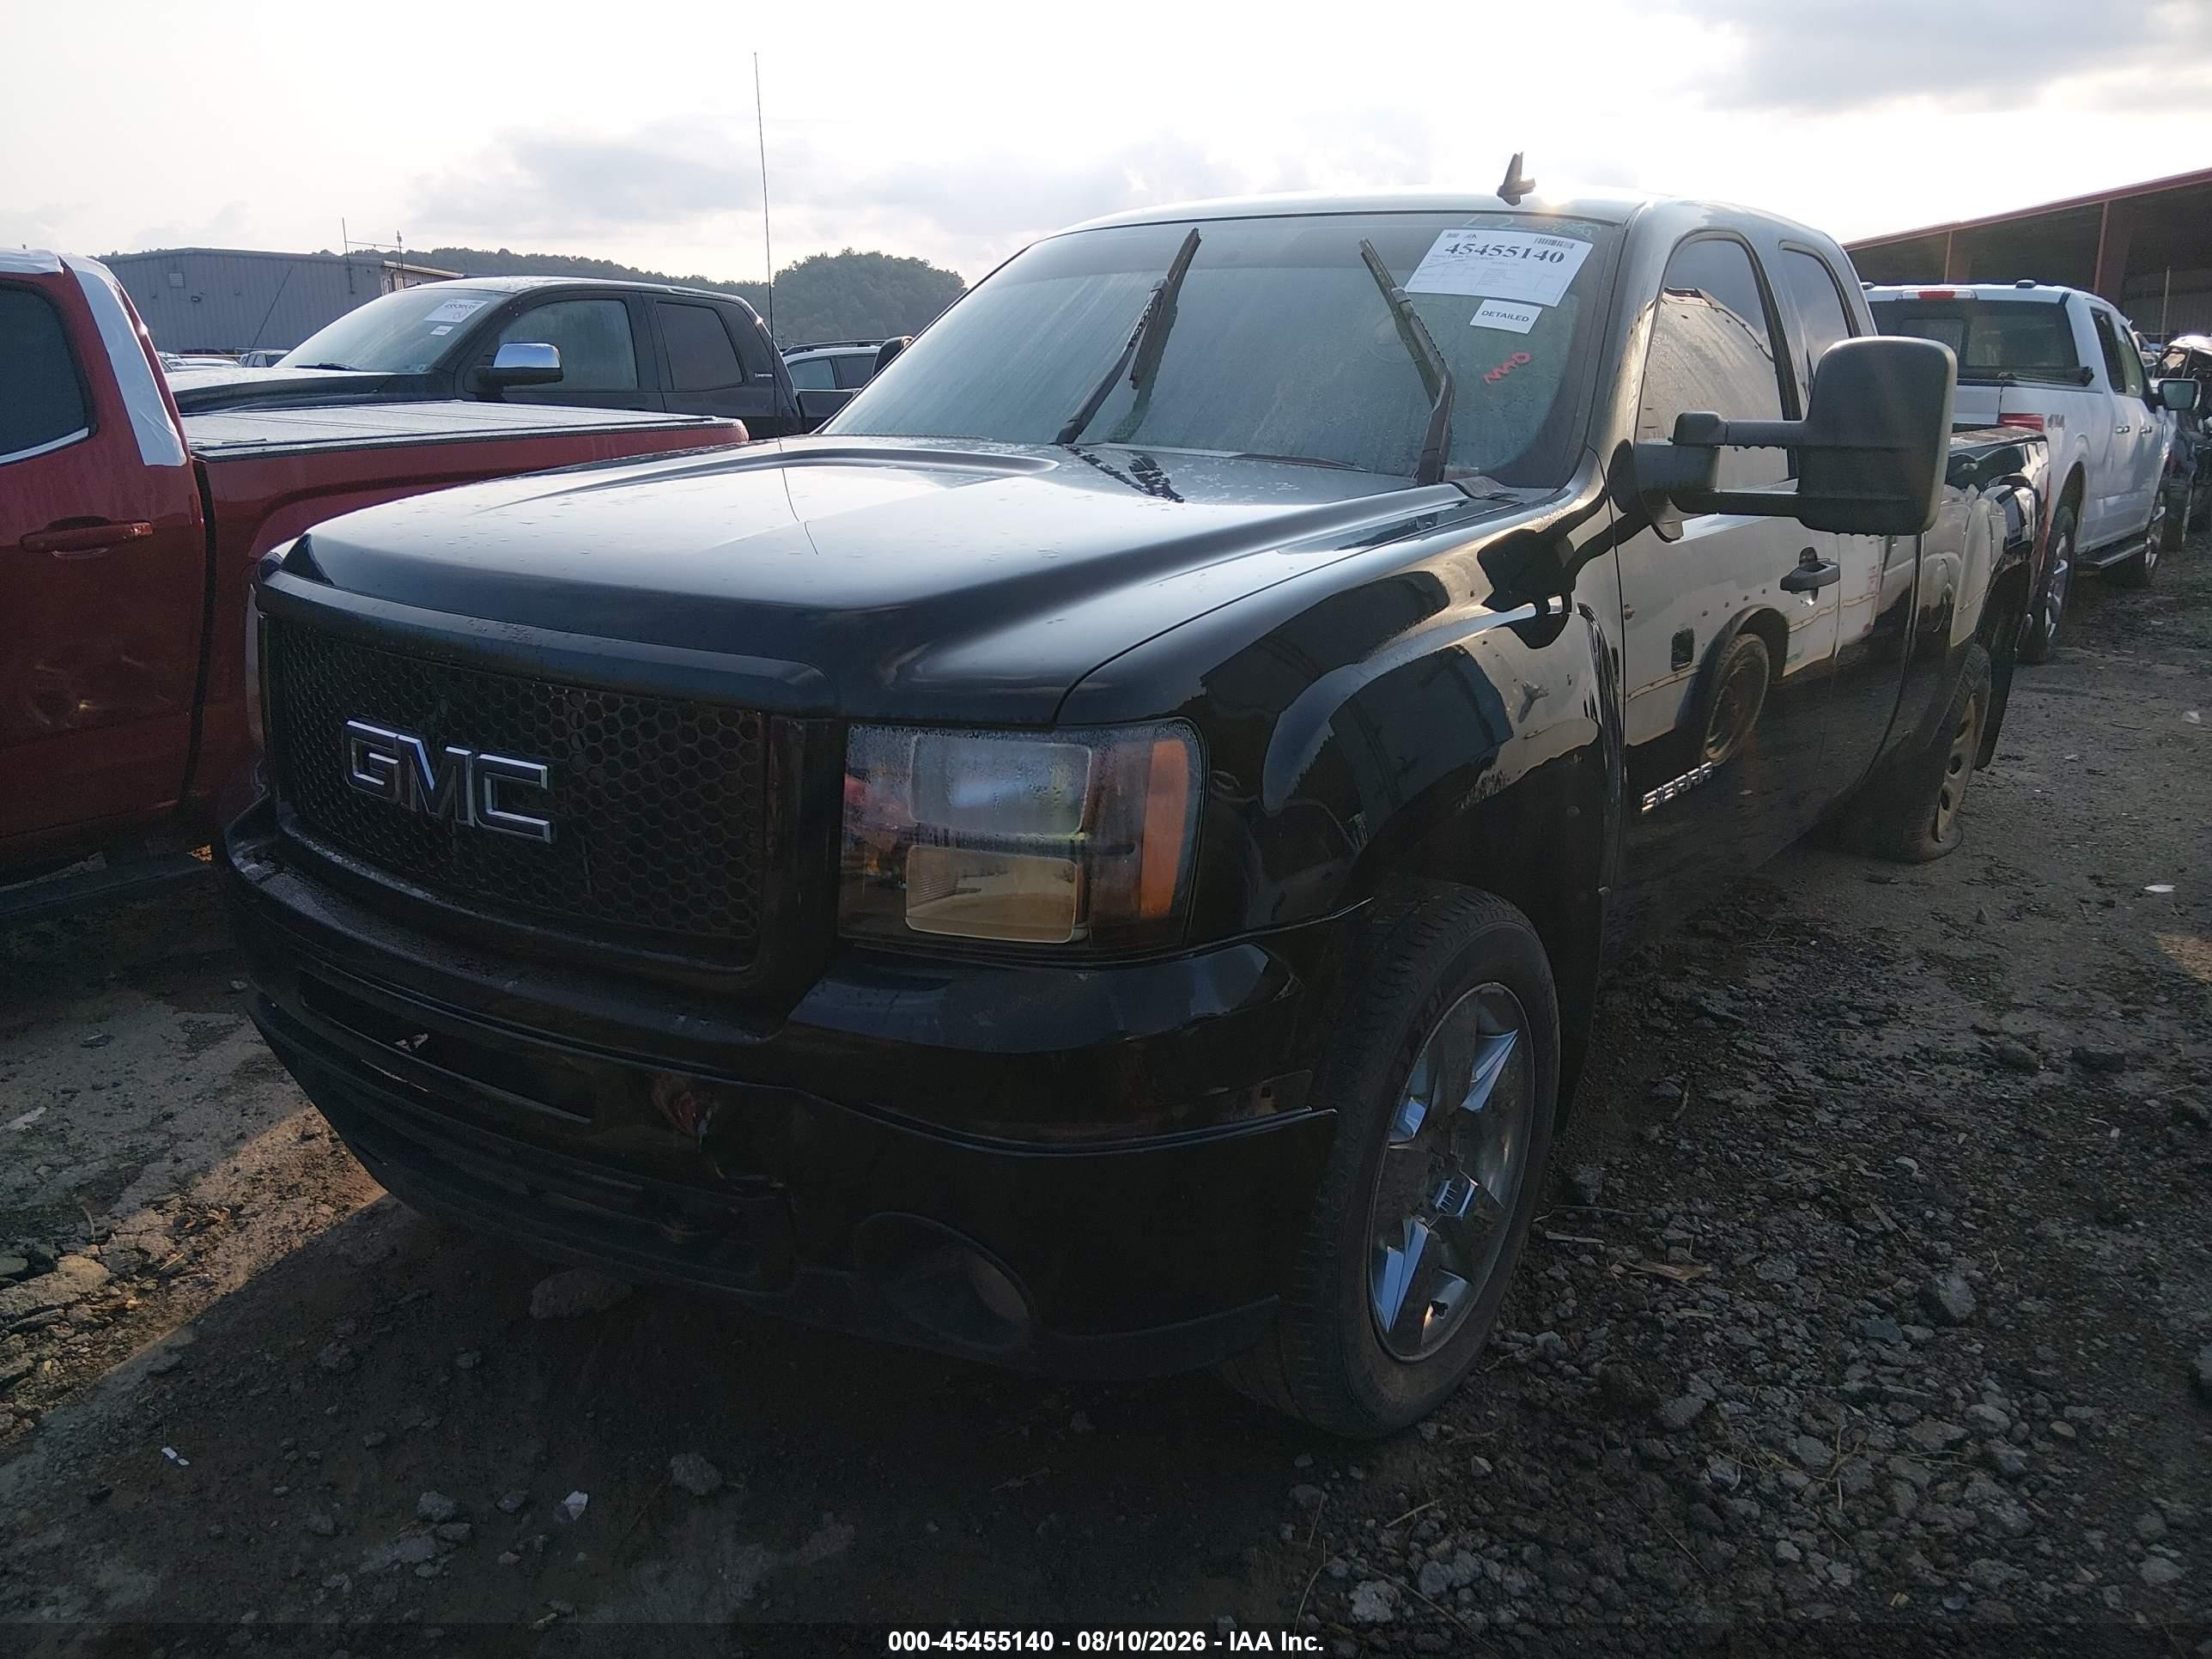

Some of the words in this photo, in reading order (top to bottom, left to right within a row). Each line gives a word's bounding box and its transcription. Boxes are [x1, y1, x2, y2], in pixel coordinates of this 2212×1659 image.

[1444, 242, 1565, 264] 45455140
[1481, 309, 1530, 323] DETAILED
[343, 719, 552, 845] GMC
